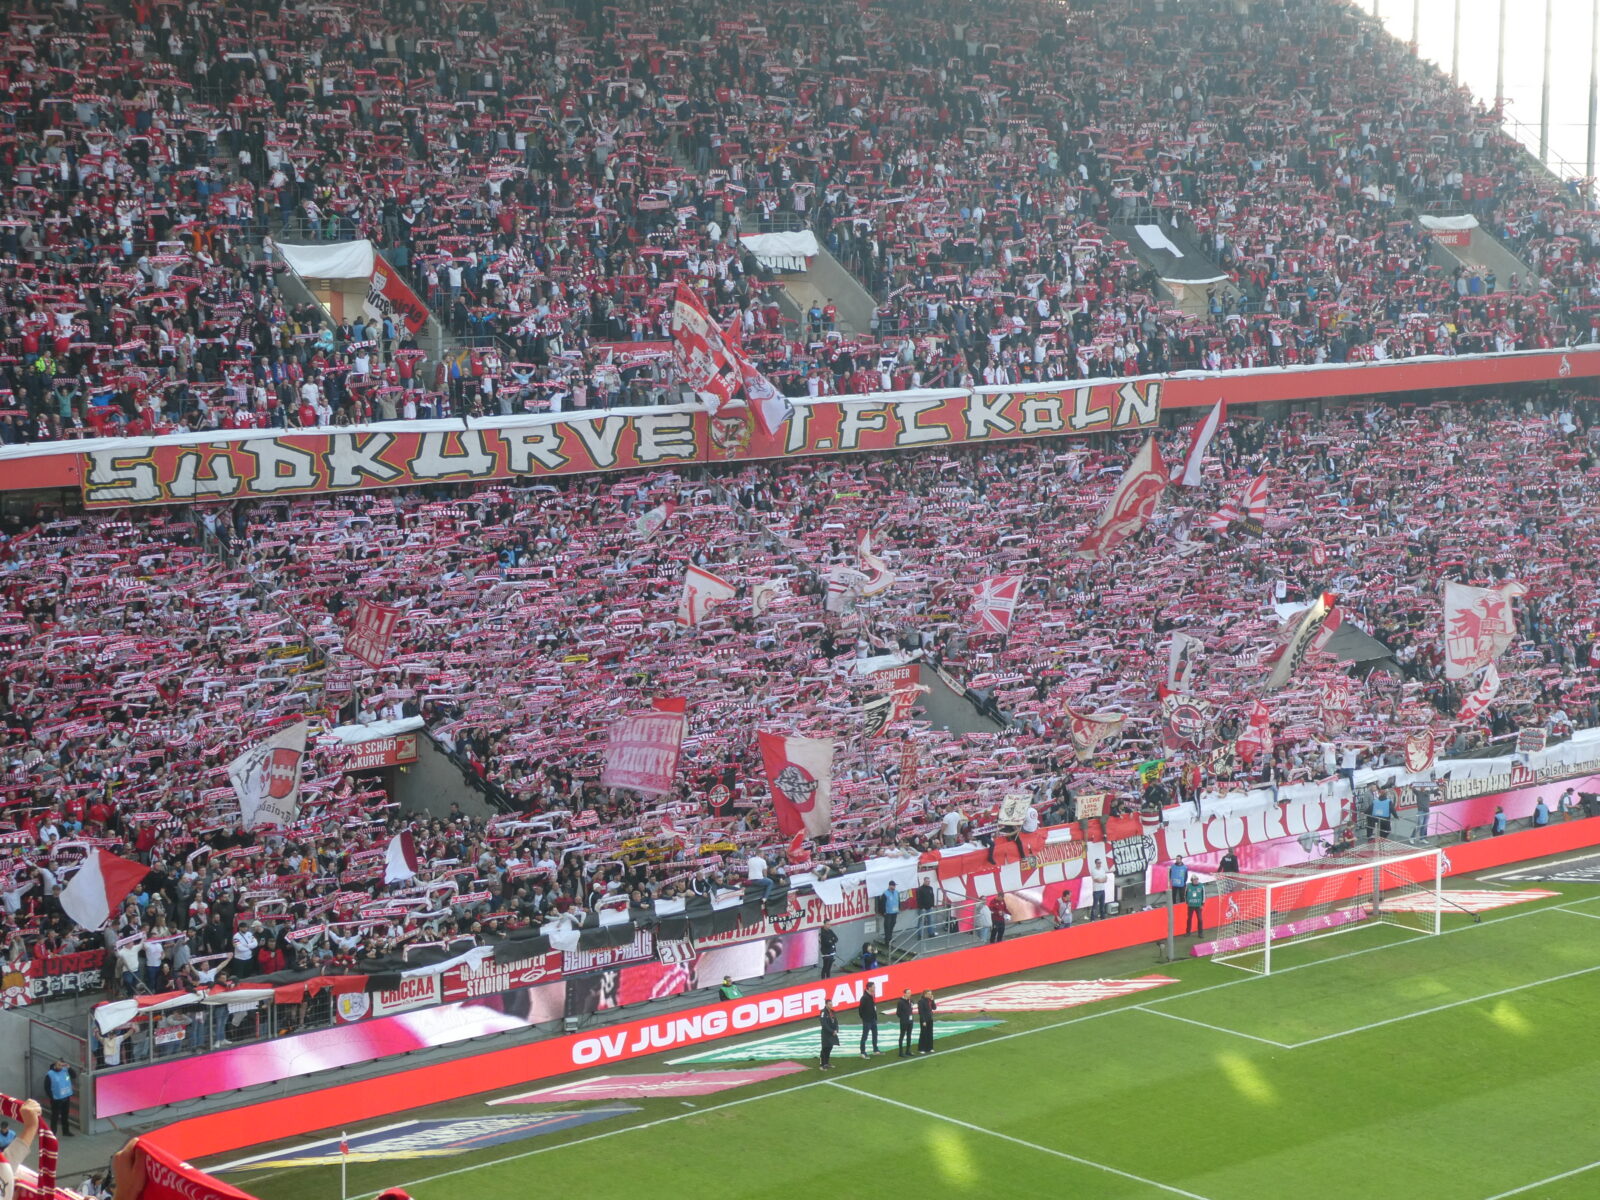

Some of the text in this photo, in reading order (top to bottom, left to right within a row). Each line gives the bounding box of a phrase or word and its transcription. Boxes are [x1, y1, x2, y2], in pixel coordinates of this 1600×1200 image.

[86, 412, 696, 502] SÜDKURVE
[964, 382, 1161, 439] KÖLN
[1114, 844, 1143, 863] STADT
[1117, 859, 1147, 876] VERBOT
[466, 974, 510, 997] STADION
[571, 1031, 628, 1065] OV
[631, 1009, 730, 1053] JUNG
[731, 989, 833, 1030] ODER
